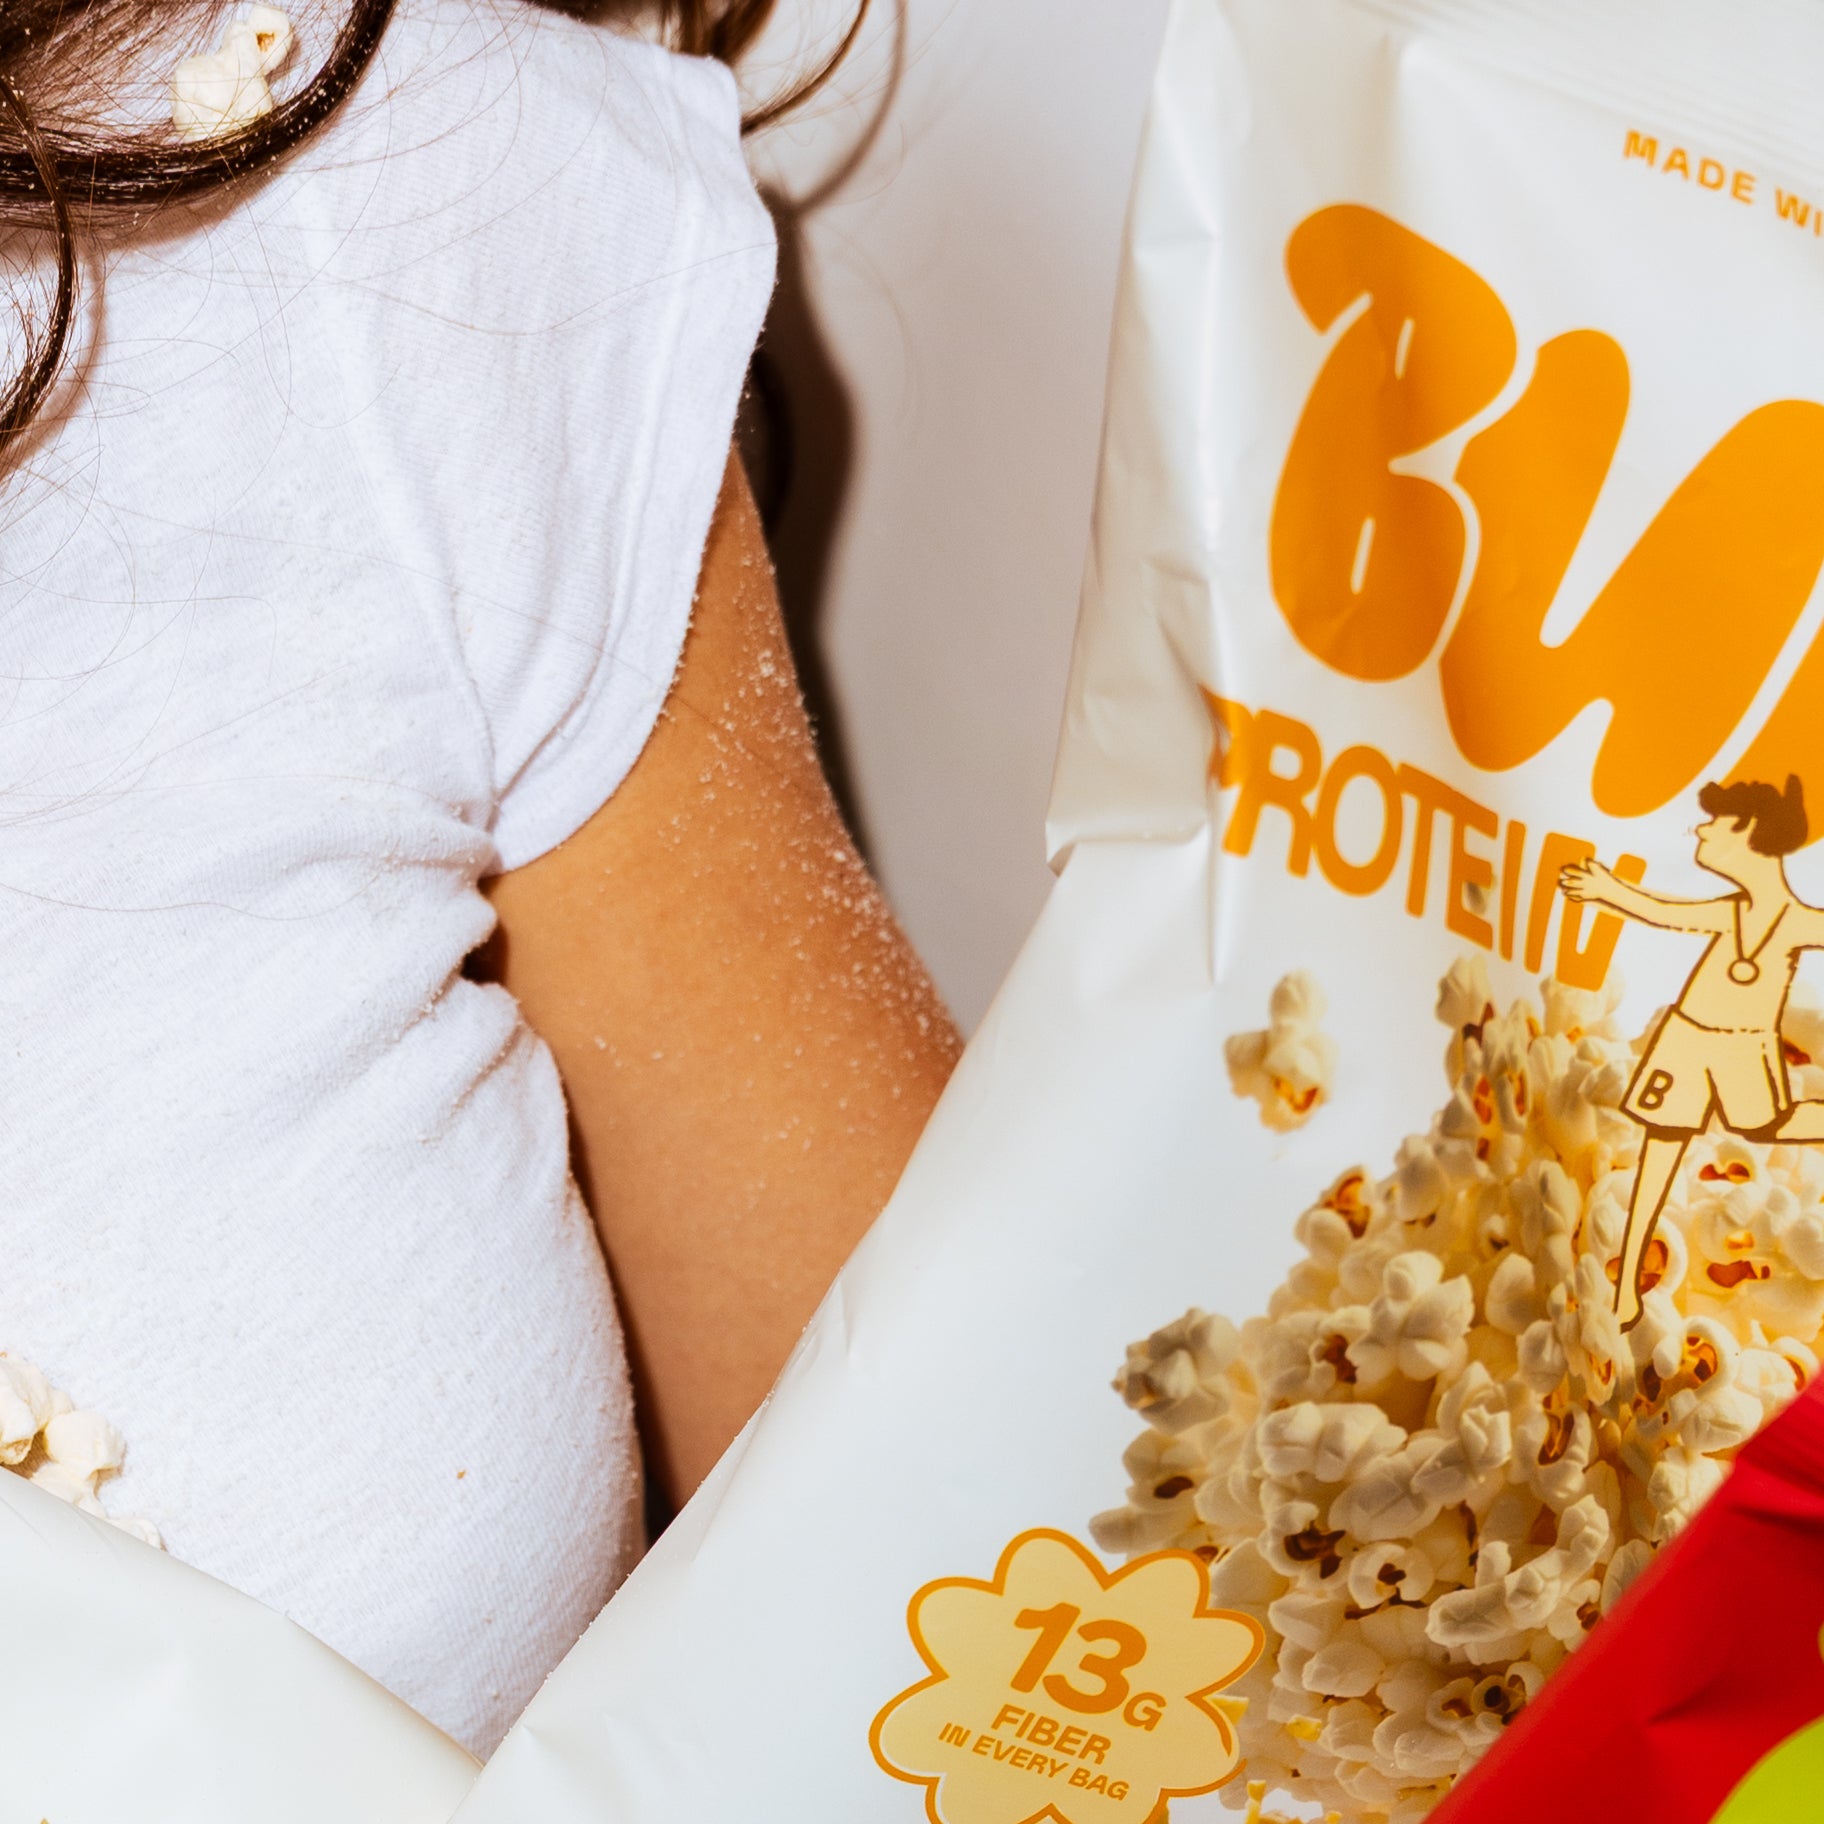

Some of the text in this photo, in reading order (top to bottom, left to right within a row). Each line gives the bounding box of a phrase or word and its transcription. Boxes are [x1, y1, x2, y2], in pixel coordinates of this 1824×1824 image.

[1623, 129, 1824, 237] MADE WI
[1268, 203, 1824, 850] BU
[938, 1722, 1130, 1802] IN EVERY BAG
[990, 1703, 1112, 1766] FIBER
